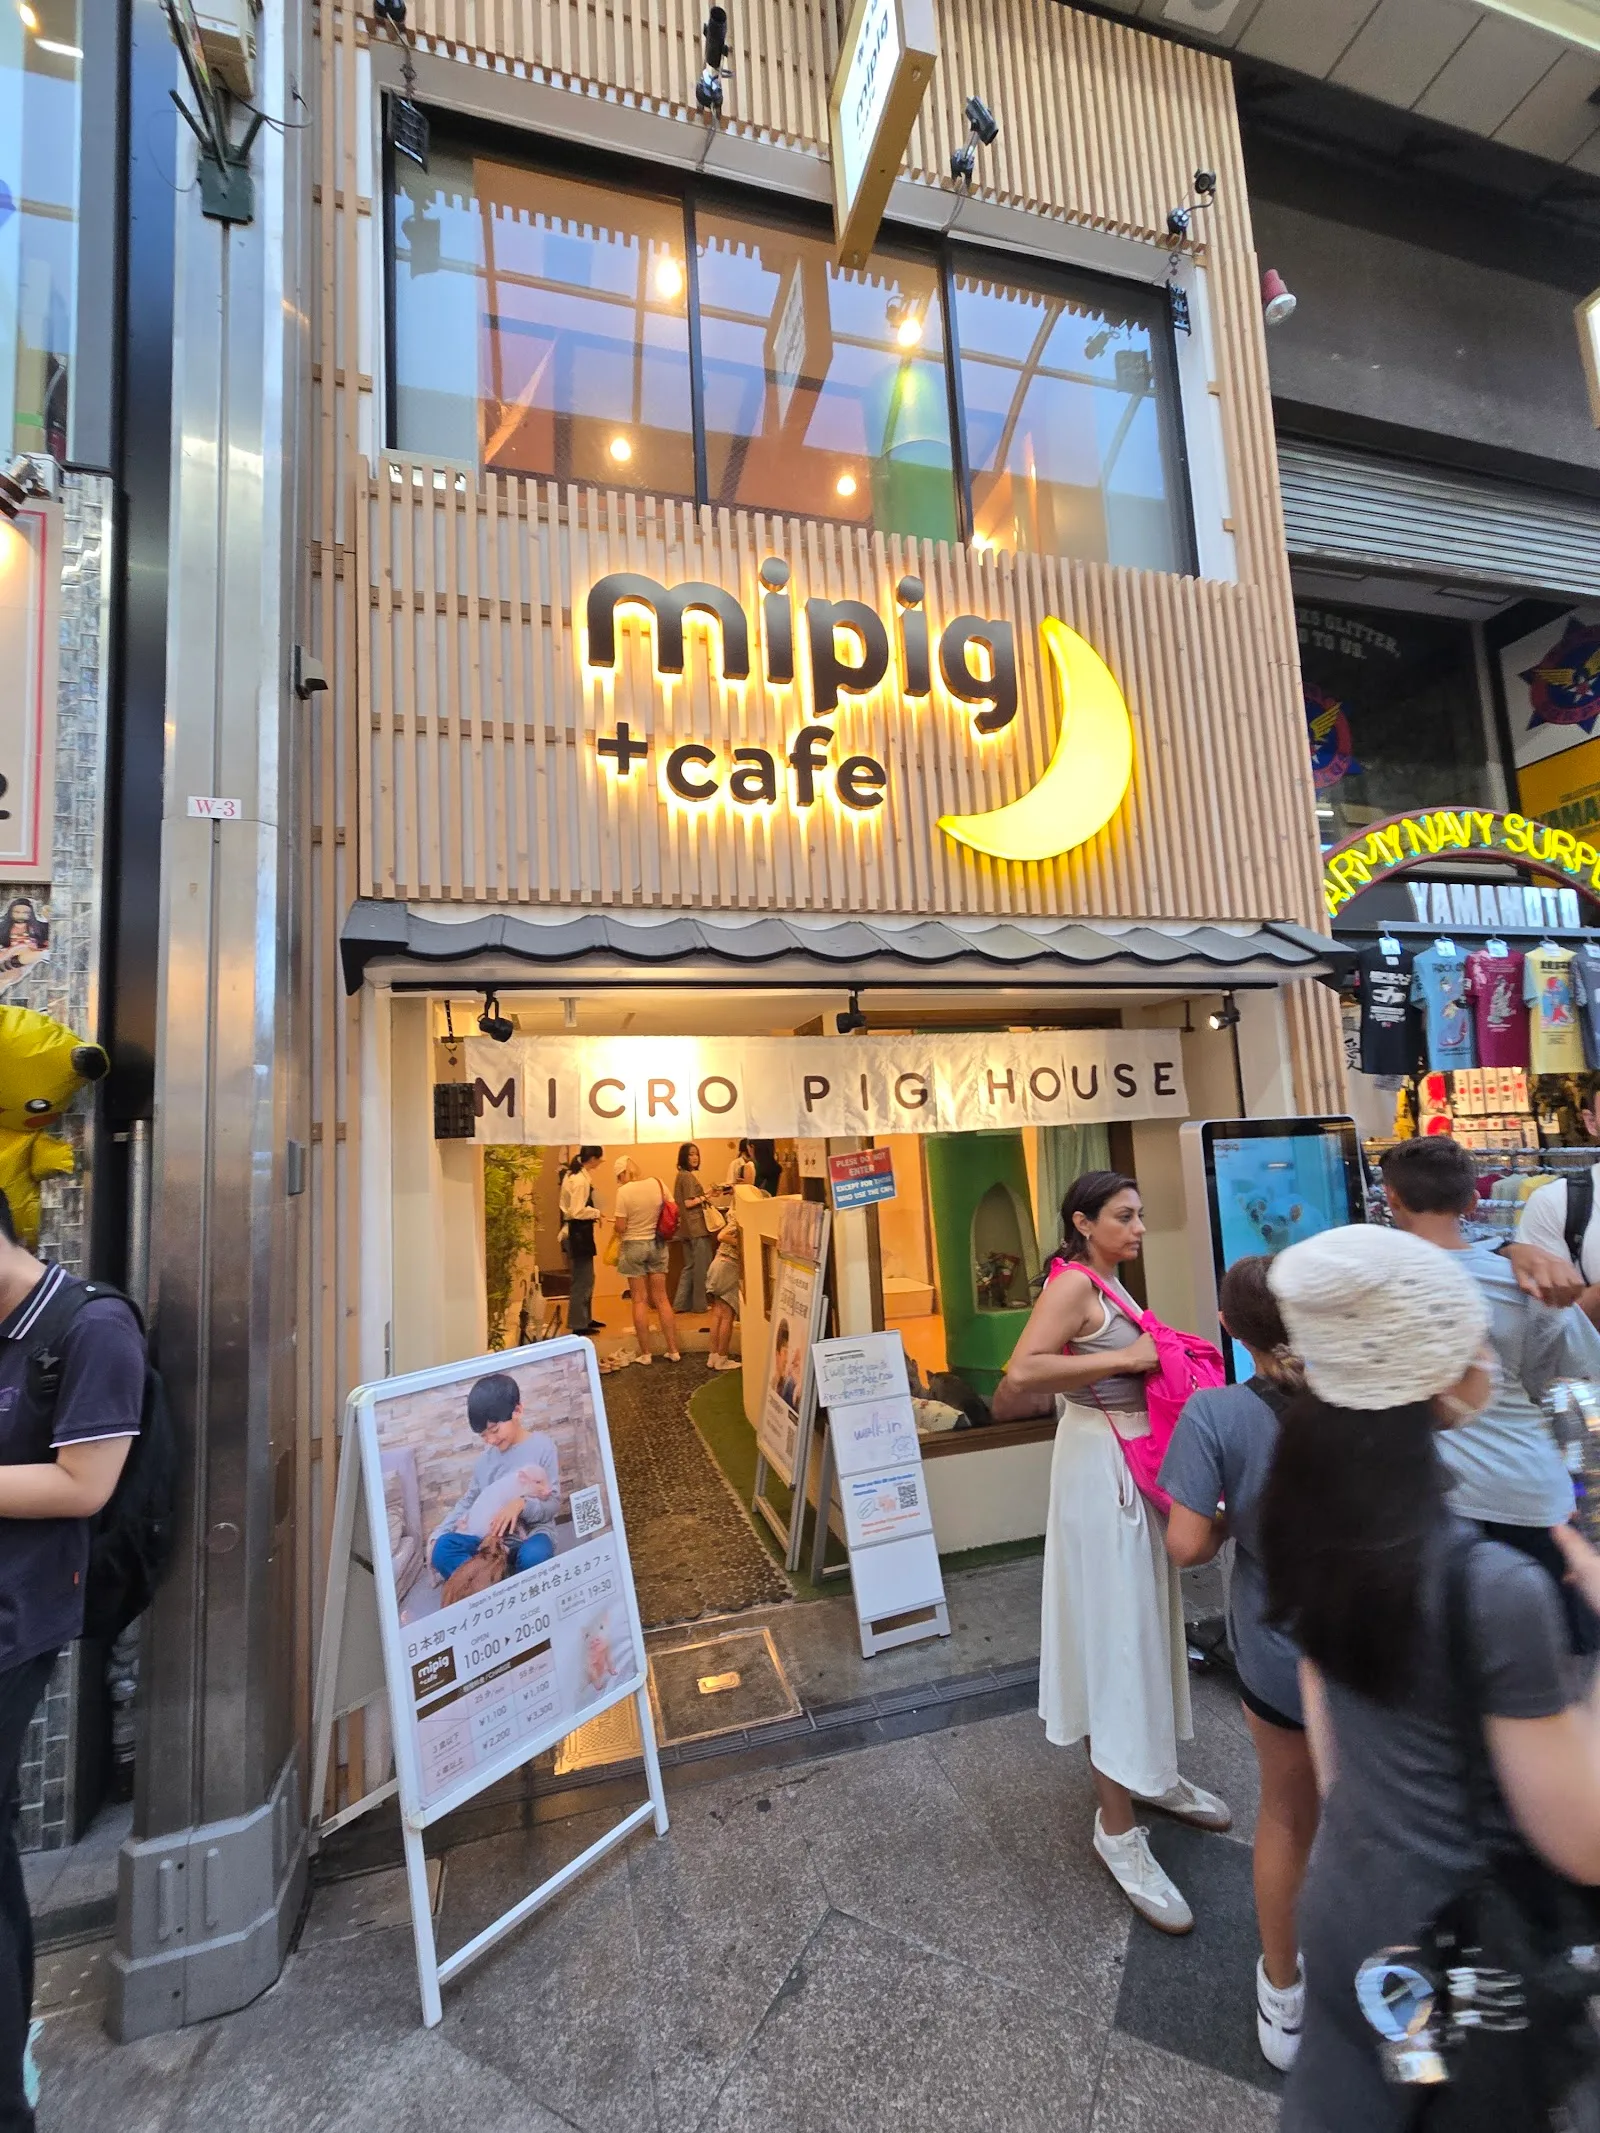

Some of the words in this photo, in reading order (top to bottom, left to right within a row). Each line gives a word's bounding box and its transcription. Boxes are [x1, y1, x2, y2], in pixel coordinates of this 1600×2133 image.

[586, 556, 1019, 734] mipig
[195, 799, 235, 817] W-3
[1322, 824, 1404, 918] ARMY
[1401, 811, 1495, 855] NAVY
[474, 1075, 738, 1119] MICRO
[803, 1072, 929, 1113] PIG
[985, 1062, 1177, 1105] HOUSE
[849, 1164, 875, 1177] ENTER
[854, 1412, 883, 1440] walk
[887, 1419, 902, 1433] in
[520, 1606, 541, 1621] CLOSE
[464, 1639, 501, 1669] 10:00
[515, 1613, 551, 1643] 20:00
[471, 1631, 490, 1646] OPEN
[418, 1655, 449, 1678] mipig
